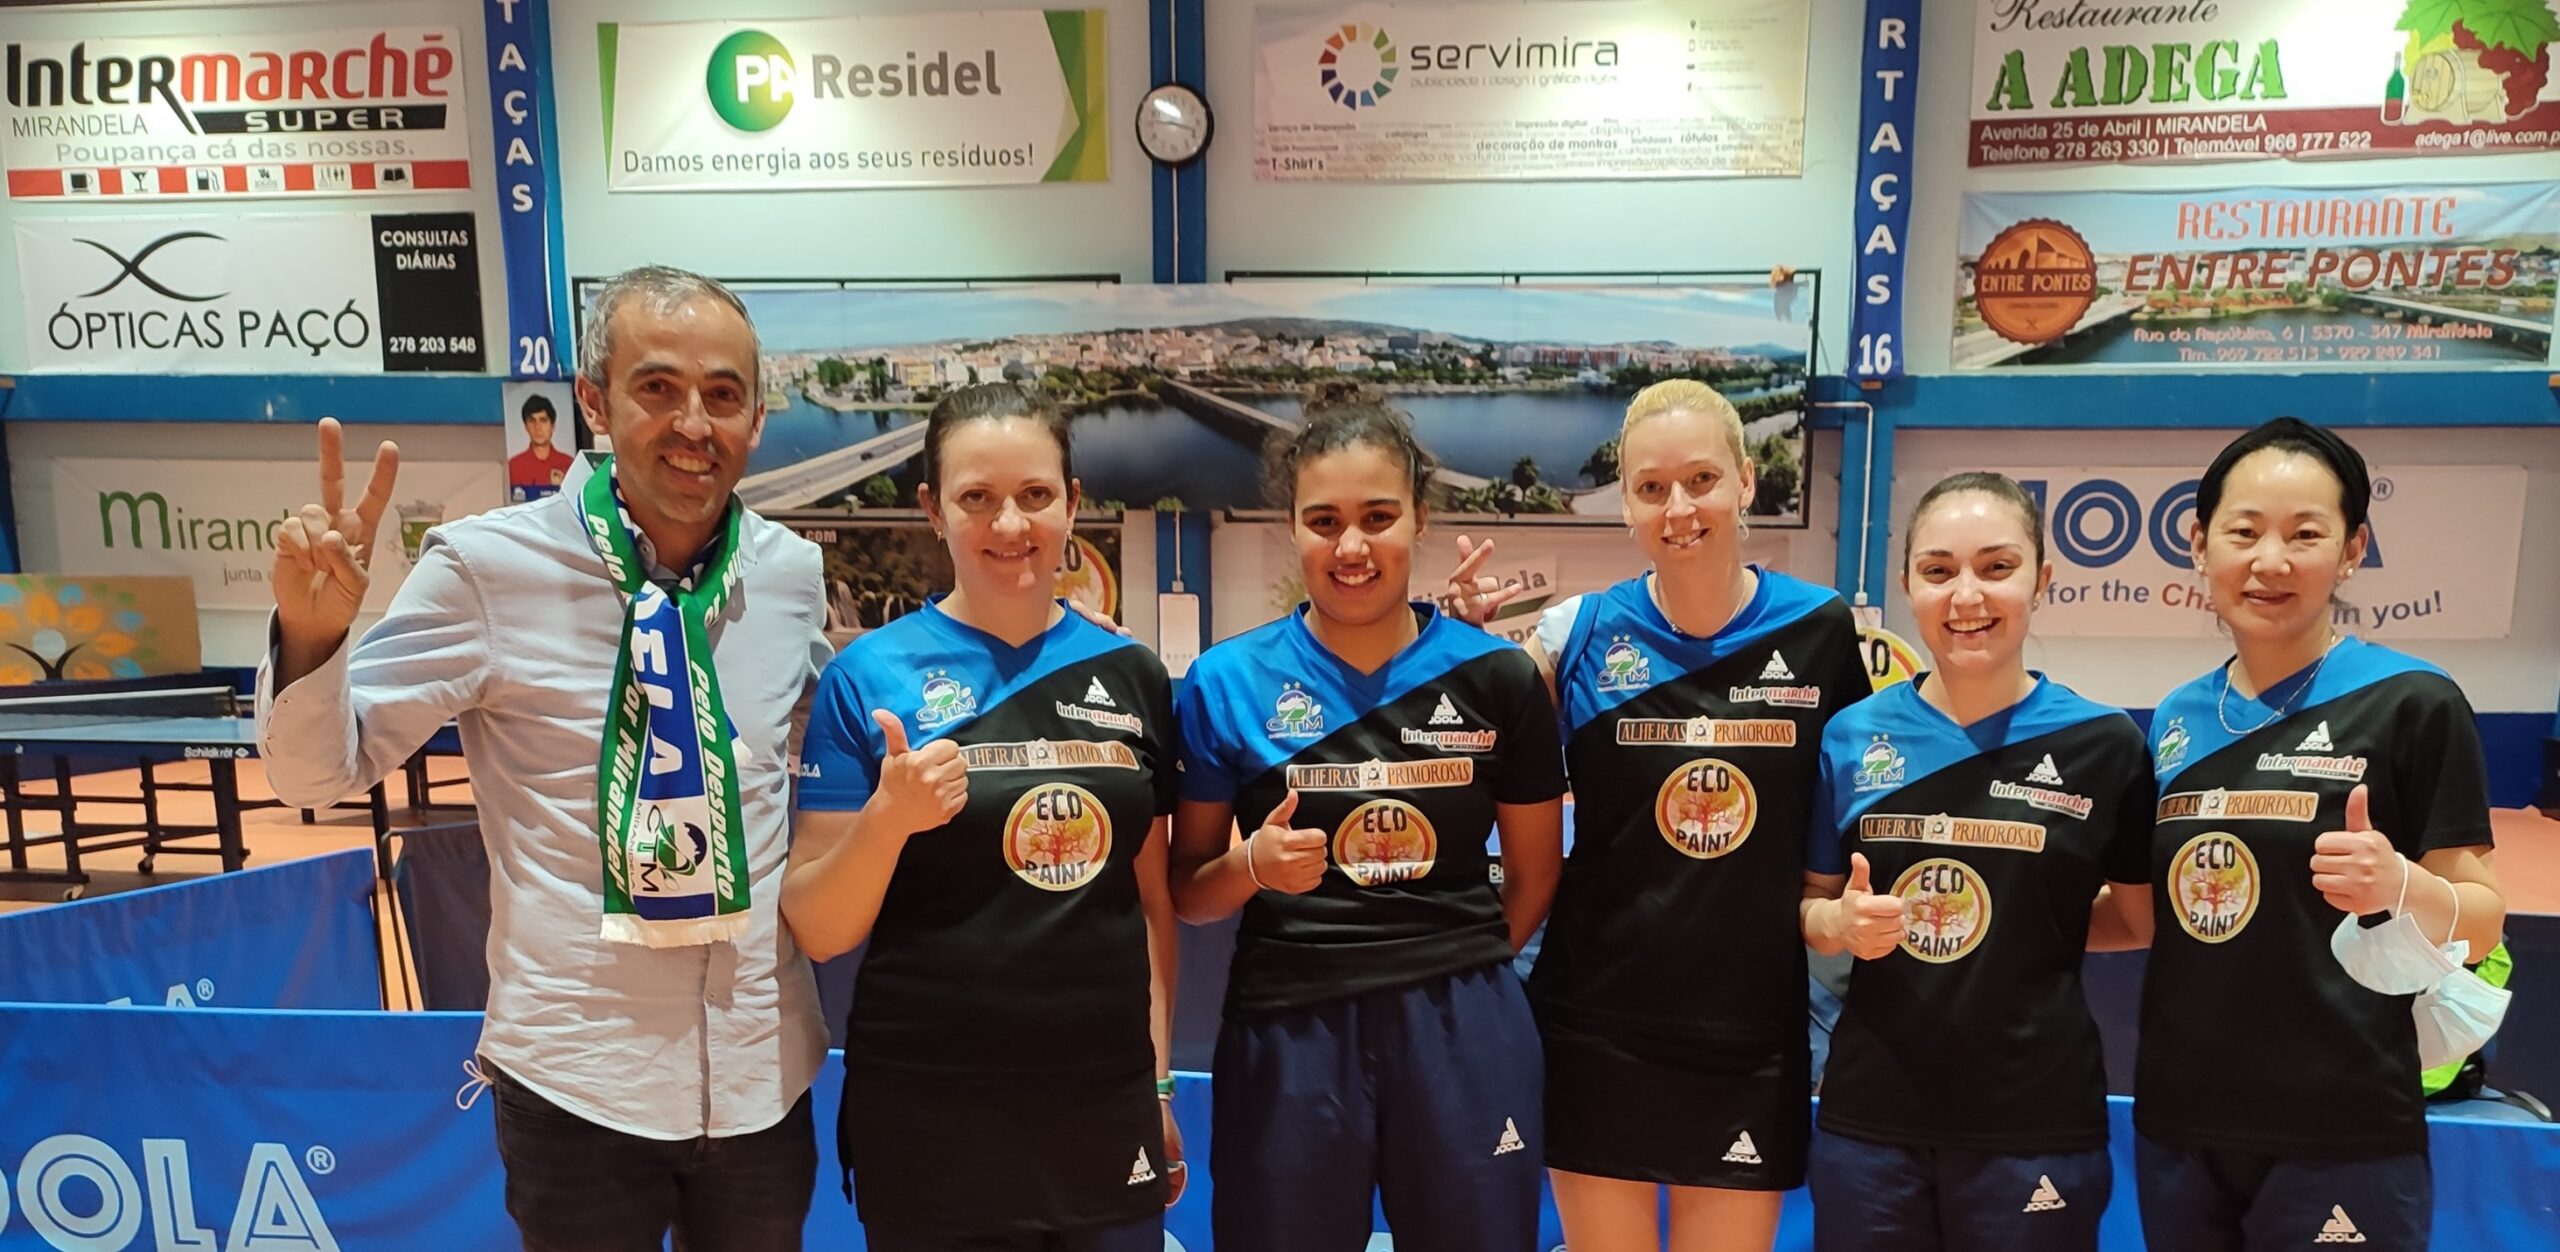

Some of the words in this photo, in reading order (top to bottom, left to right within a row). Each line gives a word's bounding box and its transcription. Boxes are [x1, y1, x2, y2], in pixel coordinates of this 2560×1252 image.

[1990, 0, 2219, 32] Restaurante
[1410, 37, 1618, 71] servimira
[6, 31, 453, 135] Intermarché
[812, 50, 1002, 98] Residel
[1986, 49, 2034, 110] A
[2050, 38, 2288, 107] ADEGA
[13, 114, 148, 137] MIRANDELA
[246, 108, 405, 132] SUPER
[1981, 123, 2047, 142] Avenida
[2052, 121, 2073, 140] 25
[2078, 119, 2099, 138] de
[2100, 118, 2141, 138] Abril
[2155, 114, 2267, 135] MIRANDELA
[57, 143, 195, 166] Poupança
[206, 140, 237, 160] cá
[247, 138, 297, 159] das
[307, 138, 414, 158] nossas.
[624, 150, 703, 173] Damos
[712, 146, 801, 176] energia
[809, 151, 849, 169] aos
[857, 147, 913, 168] seus
[921, 143, 1034, 167] resíduos!
[1982, 144, 2050, 162] Telefone
[2054, 142, 2086, 160] 278
[2091, 140, 2122, 158] 263
[2127, 138, 2159, 157] 330
[2174, 135, 2259, 154] Telemóvel
[2302, 132, 2334, 149] 777
[2338, 131, 2372, 149] 522
[2177, 196, 2456, 241] RESTAURANTE
[380, 230, 468, 247] CONSULTAS
[396, 252, 457, 270] DIÁRIAS
[2124, 252, 2292, 293] ENTRE
[2306, 249, 2521, 291] PONTES
[1981, 274, 2024, 293] ENTRE
[2032, 272, 2092, 293] PONTES
[48, 302, 224, 351] ÓPTICAS
[240, 300, 370, 356] PAÇÓ
[2133, 328, 2165, 342] Rua
[390, 337, 416, 353] 278
[420, 336, 446, 353] 203
[450, 336, 477, 353] 548
[519, 336, 550, 374] 20
[1858, 333, 1892, 375] 16
[589, 514, 627, 582] Pelo
[223, 562, 262, 586] junta
[2048, 581, 2091, 604] for
[2102, 579, 2149, 603] the
[2372, 590, 2442, 629] you!
[1758, 670, 1796, 680] JOOLA
[1427, 715, 1464, 726] JOOLA
[1620, 722, 1687, 743] ALHEIRAS
[1713, 722, 1793, 743] PRIMOROSAS
[690, 660, 717, 743] Pelo
[704, 750, 736, 900] Desporto
[1290, 765, 1361, 788] ALHEIRAS
[1386, 761, 1471, 785] PRIMOROSAS
[1687, 763, 1730, 794] ECO
[2025, 772, 2064, 786] JOOLA
[1037, 790, 1083, 822] ECO
[1363, 804, 1408, 834] ECO
[1675, 829, 1733, 853] PAINT
[1863, 818, 1925, 840] ALHEIRAS
[1951, 822, 2043, 848] PRIMOROSAS
[2195, 837, 2236, 870] ECO
[1024, 859, 1089, 886] PAINT
[1357, 862, 1417, 886] PAINT
[1920, 864, 1966, 896] ECO
[2189, 910, 2239, 938] PAINT
[1906, 929, 1966, 958] PAINT
[1492, 1140, 1527, 1156] JOOLA
[1721, 1151, 1763, 1165] JOOLA
[1127, 1171, 1157, 1186] JOOLA
[2022, 1197, 2068, 1213] JOOLA
[2313, 1232, 2367, 1243] JOOLA
